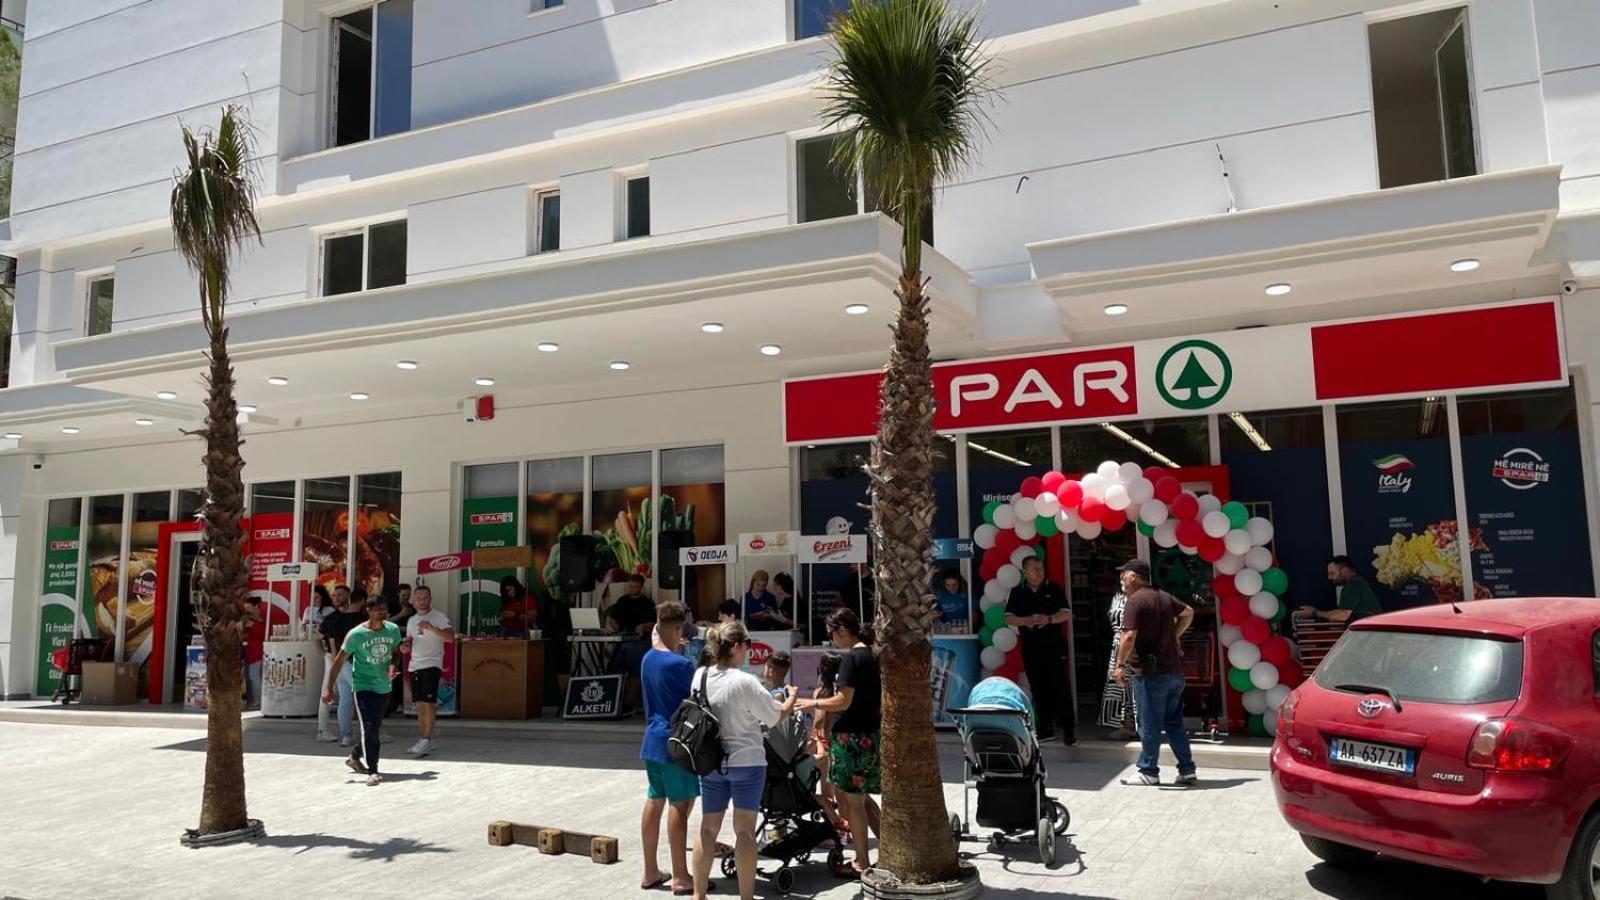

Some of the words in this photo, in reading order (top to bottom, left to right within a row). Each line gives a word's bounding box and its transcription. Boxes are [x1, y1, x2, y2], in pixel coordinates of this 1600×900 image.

[950, 359, 1130, 417] PAR
[1494, 460, 1509, 468] MË
[1510, 461, 1534, 470] MIRË
[1536, 463, 1549, 471] NË
[1379, 473, 1411, 493] Italy
[701, 550, 728, 560] DEDJA
[1341, 742, 1355, 758] AA
[1362, 746, 1384, 764] 637
[1388, 750, 1404, 768] ZA
[1432, 772, 1464, 782] AURIS
